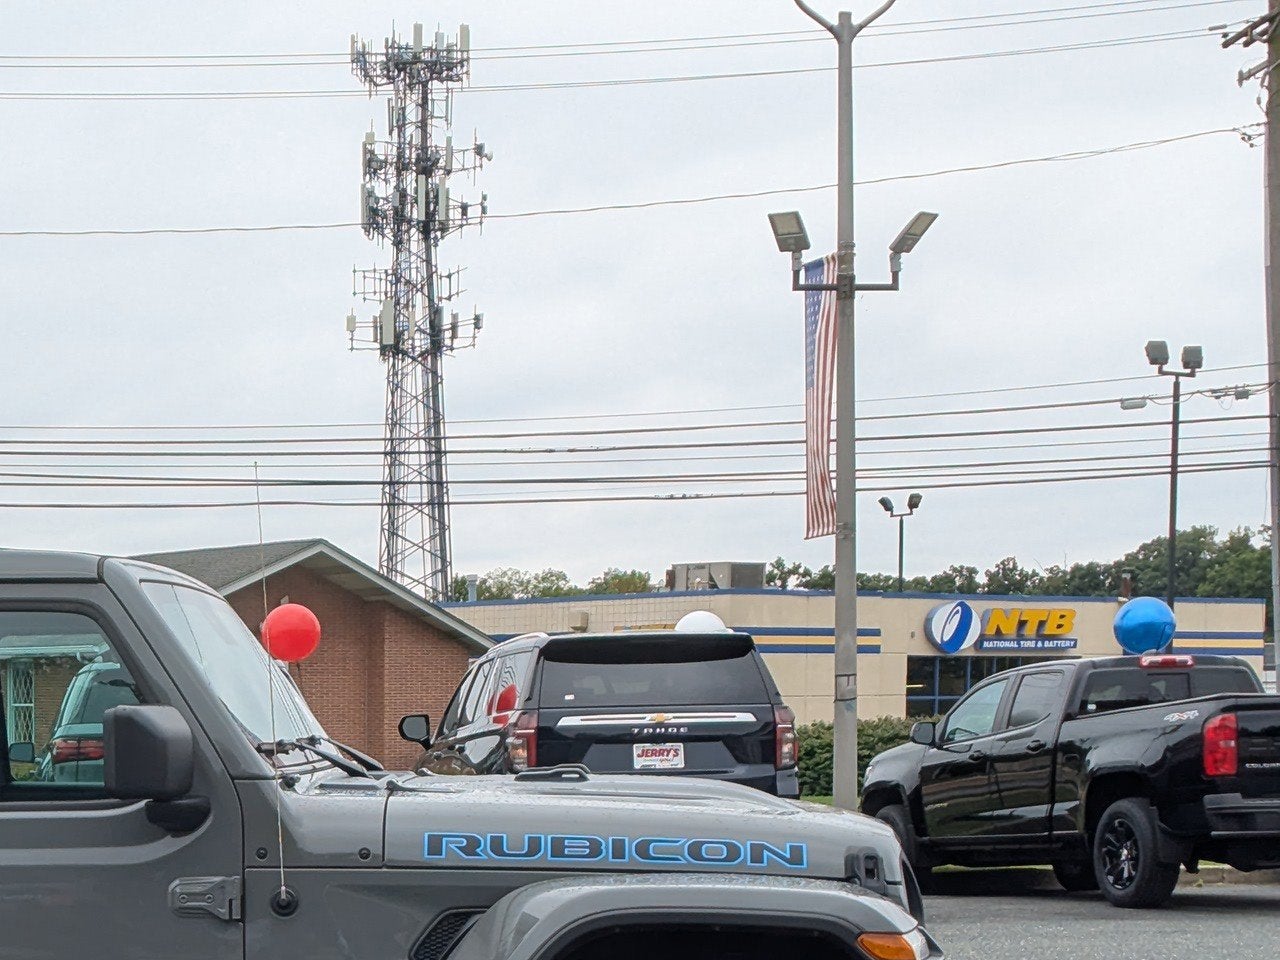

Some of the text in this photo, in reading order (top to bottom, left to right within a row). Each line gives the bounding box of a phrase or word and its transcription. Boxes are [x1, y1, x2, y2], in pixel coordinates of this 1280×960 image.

[985, 608, 1077, 635] NTB
[1044, 640, 1076, 648] BATTERY
[636, 748, 680, 758] JERRY'S
[423, 832, 808, 869] RUBICON
